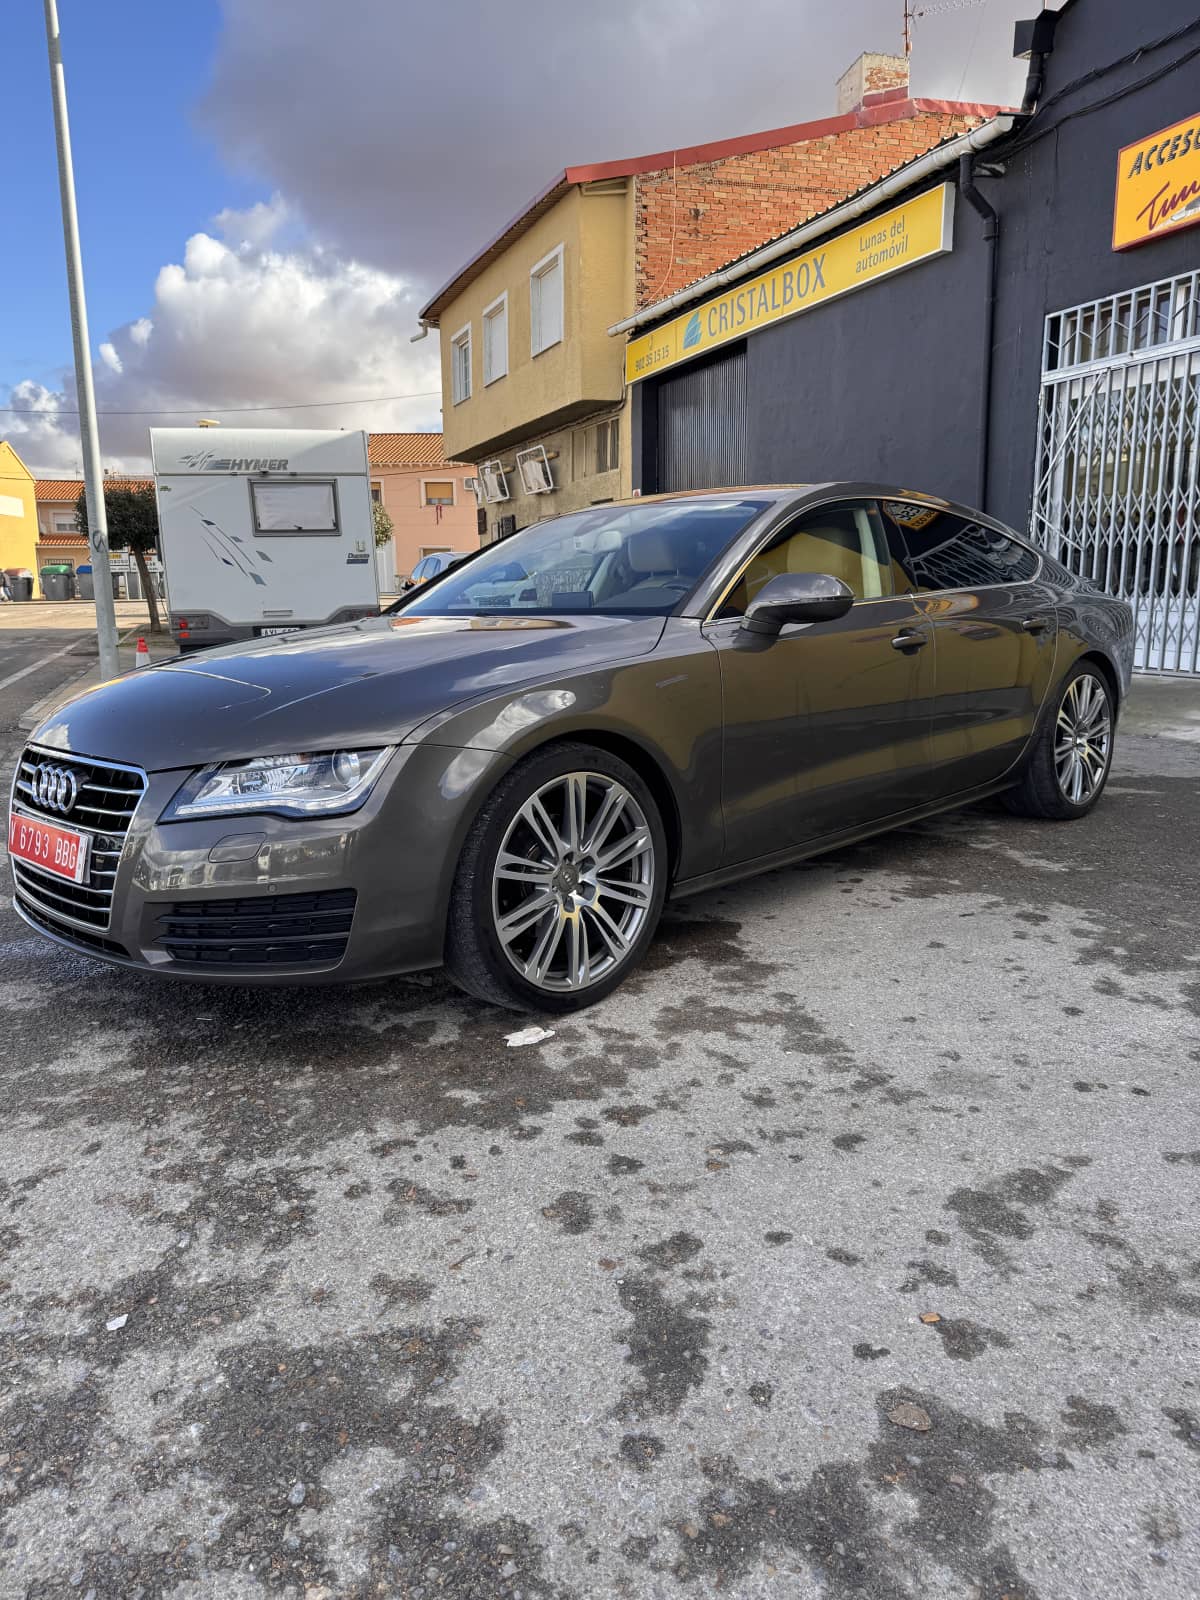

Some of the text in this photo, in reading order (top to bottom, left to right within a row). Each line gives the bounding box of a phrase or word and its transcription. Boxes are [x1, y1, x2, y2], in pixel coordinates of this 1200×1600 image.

[859, 215, 905, 252] Lunas del
[856, 237, 908, 273] automóvil
[707, 253, 826, 337] CRISTALBOX
[654, 348, 661, 363] 15
[662, 344, 670, 359] 15
[230, 459, 288, 471] HYMER
[20, 825, 50, 859] 6793
[54, 837, 77, 870] BBG
